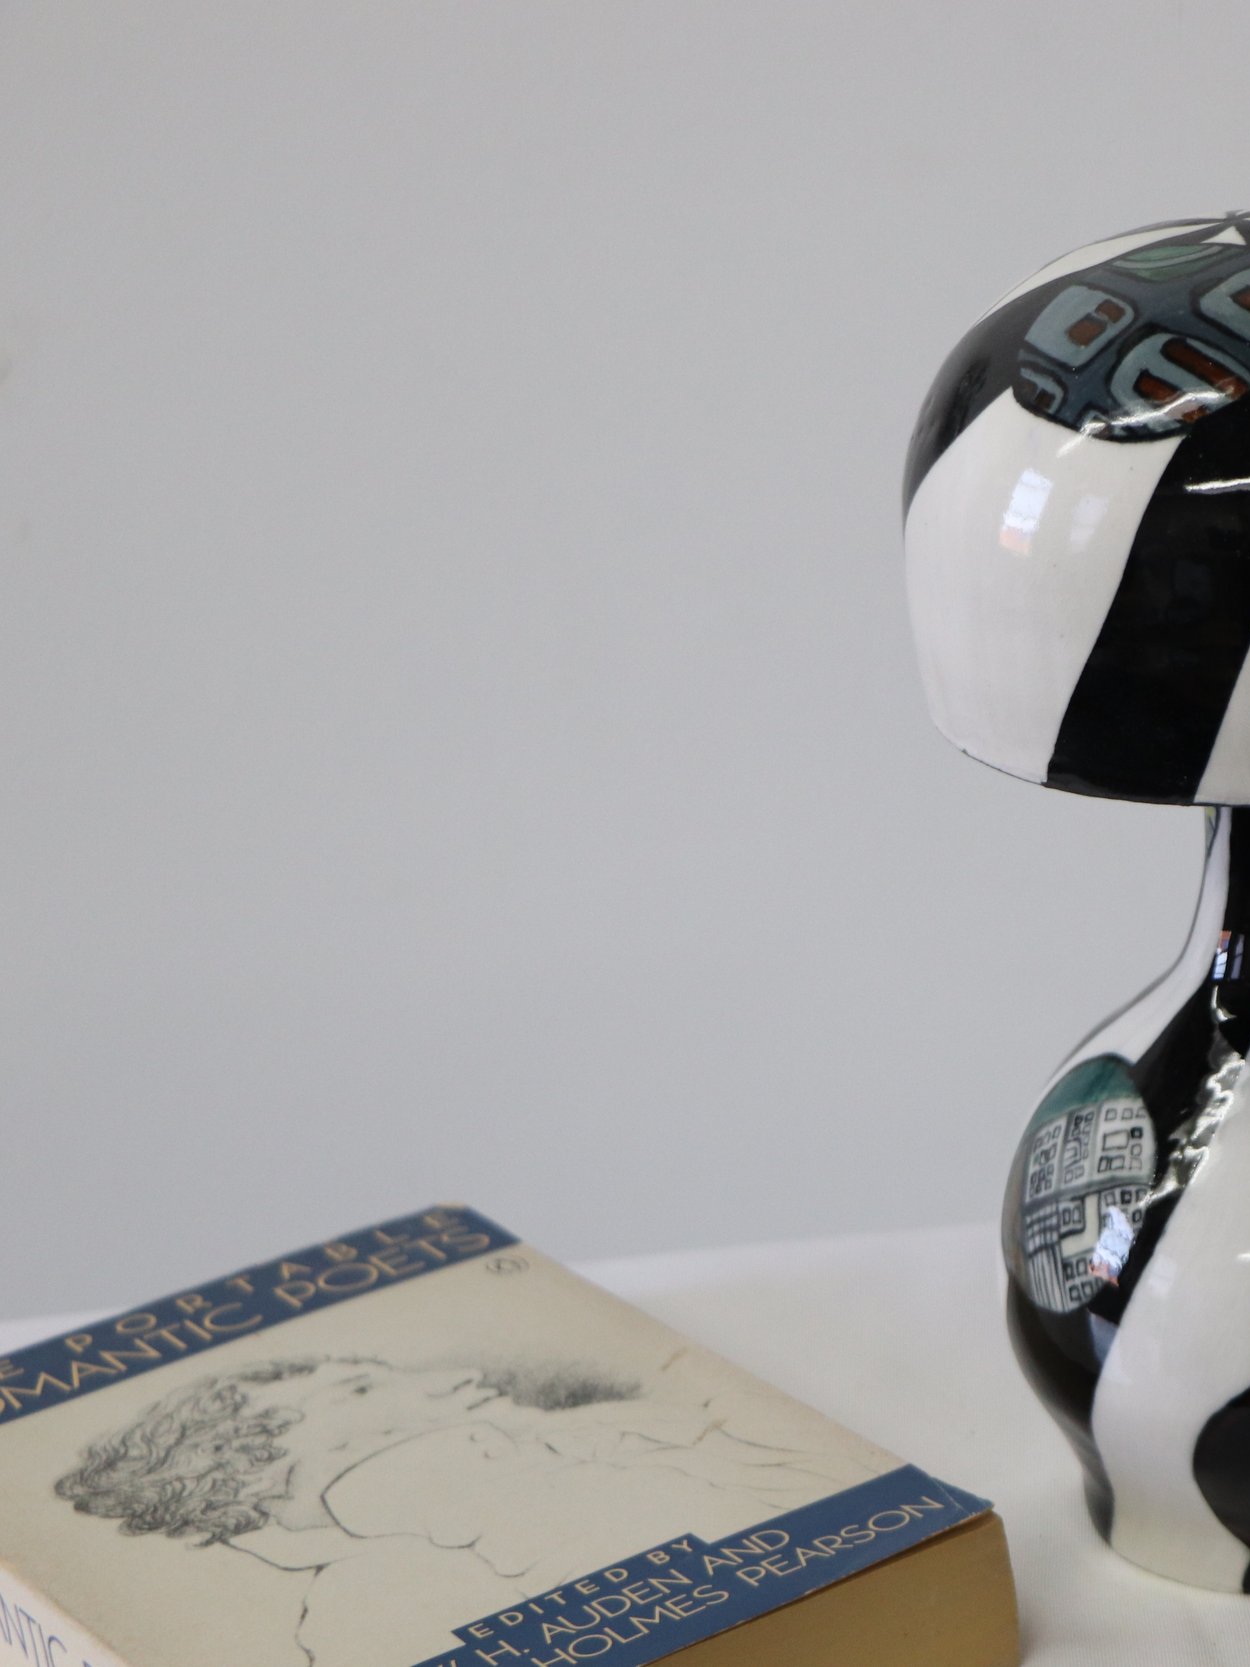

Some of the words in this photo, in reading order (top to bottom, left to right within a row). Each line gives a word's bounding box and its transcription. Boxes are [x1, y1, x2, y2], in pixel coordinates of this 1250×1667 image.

[0, 1302, 263, 1413] MANTIC
[274, 1225, 490, 1307] POETS
[65, 1211, 461, 1353] PORTABLE
[467, 1567, 628, 1638] EDITED
[647, 1539, 693, 1565] BY
[530, 1584, 729, 1667] HOLMES
[736, 1495, 944, 1586] PEARSON
[541, 1569, 693, 1644] AUDEN
[702, 1529, 790, 1576] AND
